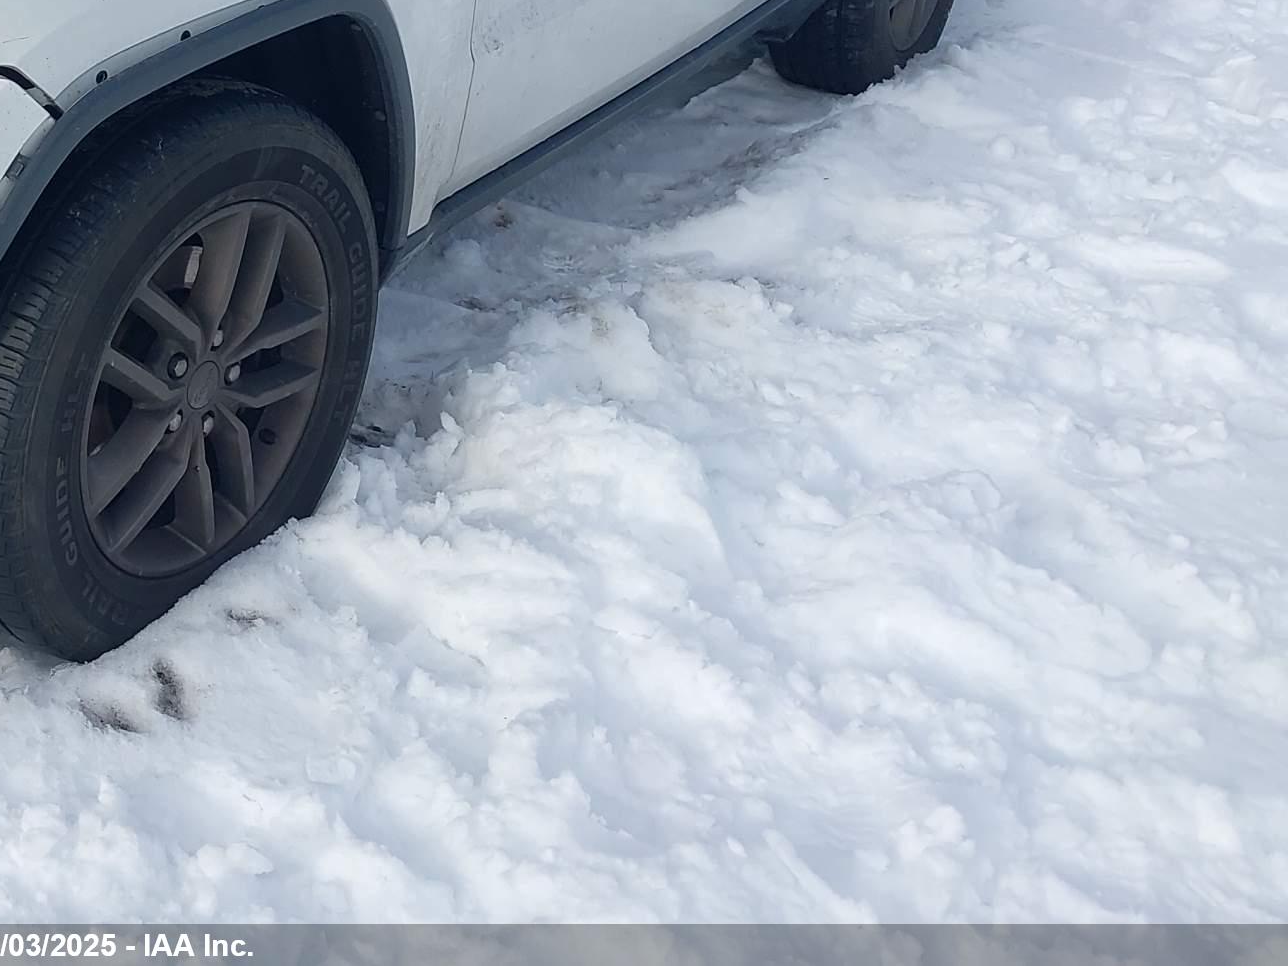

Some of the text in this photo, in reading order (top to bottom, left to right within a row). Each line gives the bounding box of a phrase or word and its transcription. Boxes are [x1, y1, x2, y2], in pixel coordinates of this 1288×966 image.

[299, 164, 352, 234] TRAIL
[348, 241, 369, 342] GUIDE
[55, 457, 78, 566] GUIDE
